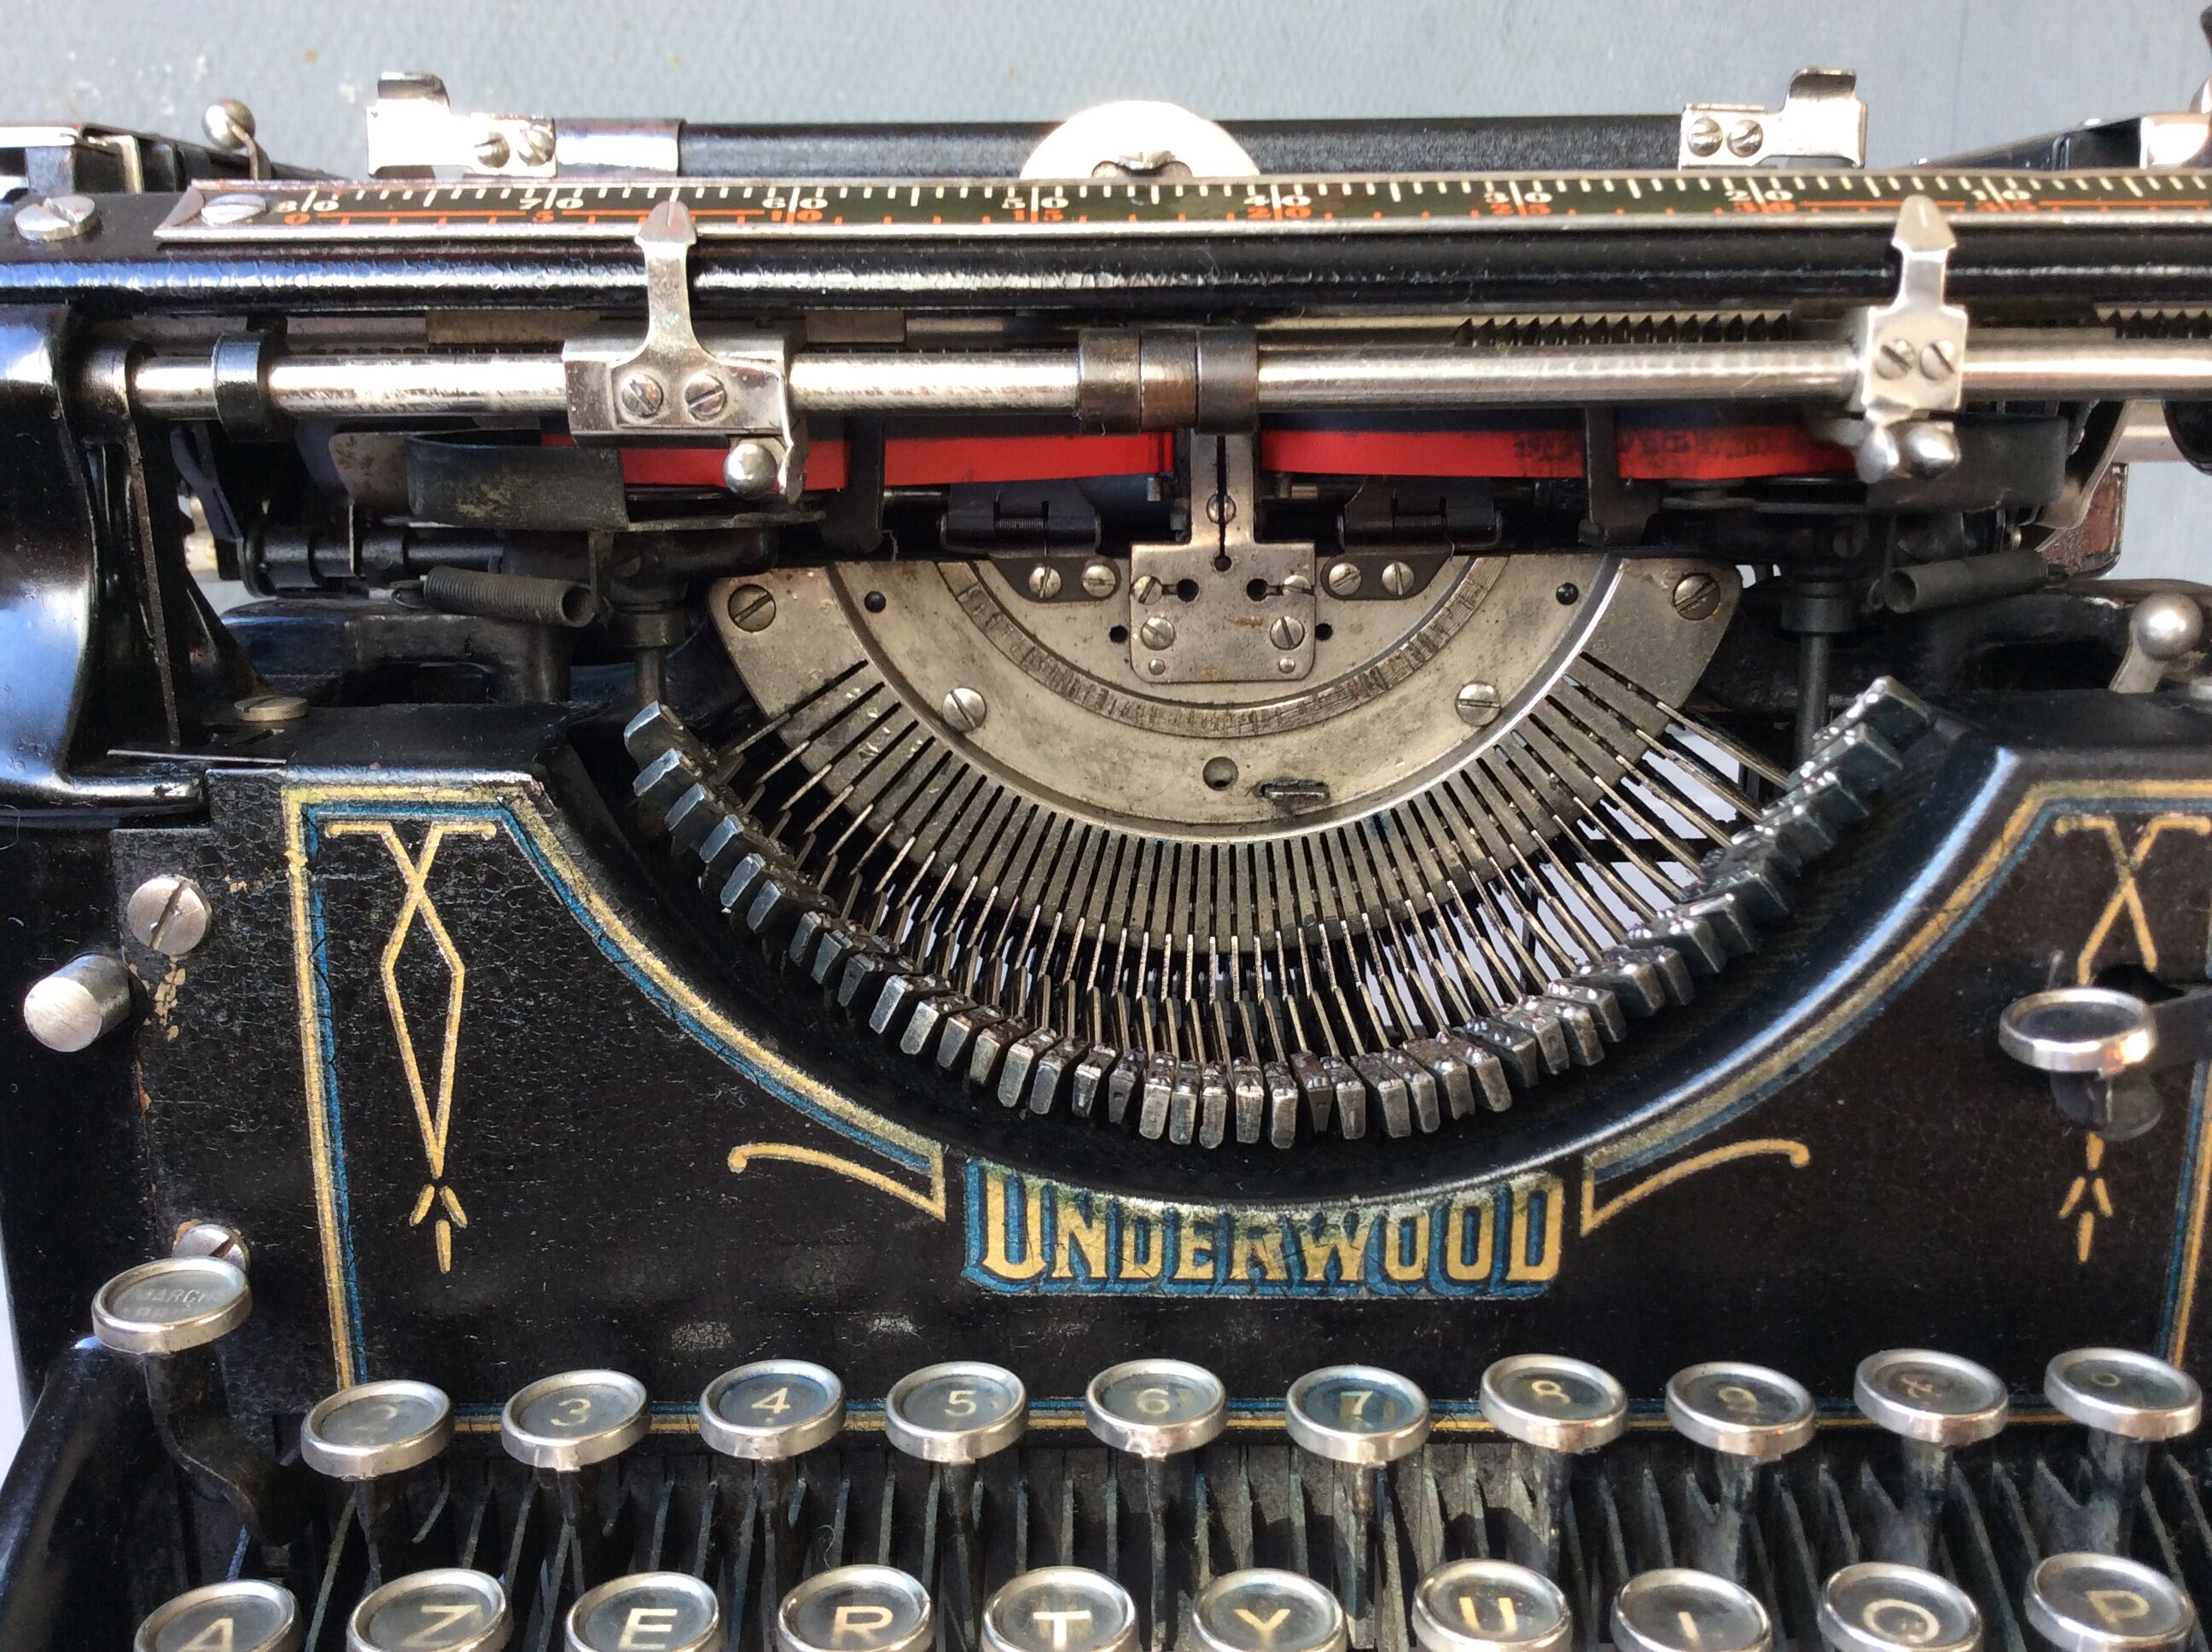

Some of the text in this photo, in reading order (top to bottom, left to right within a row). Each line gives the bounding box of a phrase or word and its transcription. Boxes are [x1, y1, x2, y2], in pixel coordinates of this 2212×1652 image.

[283, 212, 311, 225] 0
[771, 209, 823, 222] 10
[1248, 206, 1311, 219] 20
[520, 197, 584, 211] 70
[762, 196, 829, 210] 60
[1002, 196, 1068, 210] 50
[1243, 194, 1311, 207] 40
[1725, 189, 1793, 201] 20
[967, 1160, 1565, 1292] UNDERWOOD
[751, 1387, 792, 1415] 4
[944, 1389, 977, 1418] 5
[1137, 1387, 1171, 1415] 6
[1340, 1390, 1374, 1416] 7
[1531, 1379, 1572, 1407] 8
[1718, 1386, 1760, 1413] 9
[550, 1397, 592, 1428] 3
[399, 1603, 481, 1647] Z
[616, 1608, 678, 1651] E
[830, 1605, 894, 1648] R
[1031, 1610, 1093, 1652] T
[1231, 1608, 1291, 1652] Y
[1458, 1597, 1518, 1636] U
[1676, 1609, 1705, 1652] I
[2090, 1590, 2151, 1636] P
[182, 1616, 236, 1652] A
